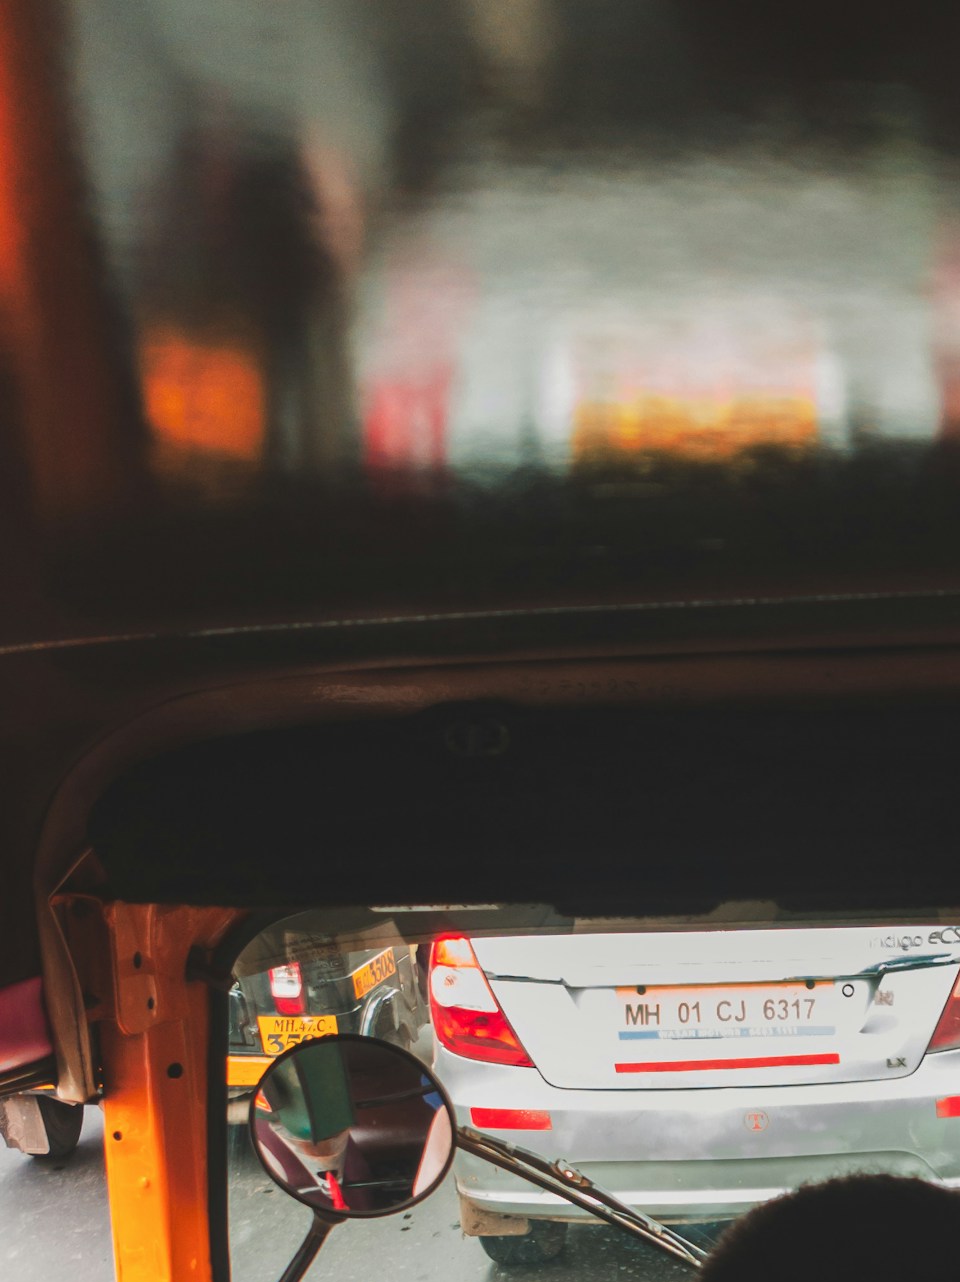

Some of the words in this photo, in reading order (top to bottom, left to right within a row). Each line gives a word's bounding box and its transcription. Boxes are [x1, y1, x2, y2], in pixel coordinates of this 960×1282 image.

[625, 1003, 660, 1025] MH
[678, 1001, 701, 1023] 01
[716, 999, 746, 1021] CJ
[763, 998, 816, 1020] 6317
[886, 1057, 907, 1069] LX
